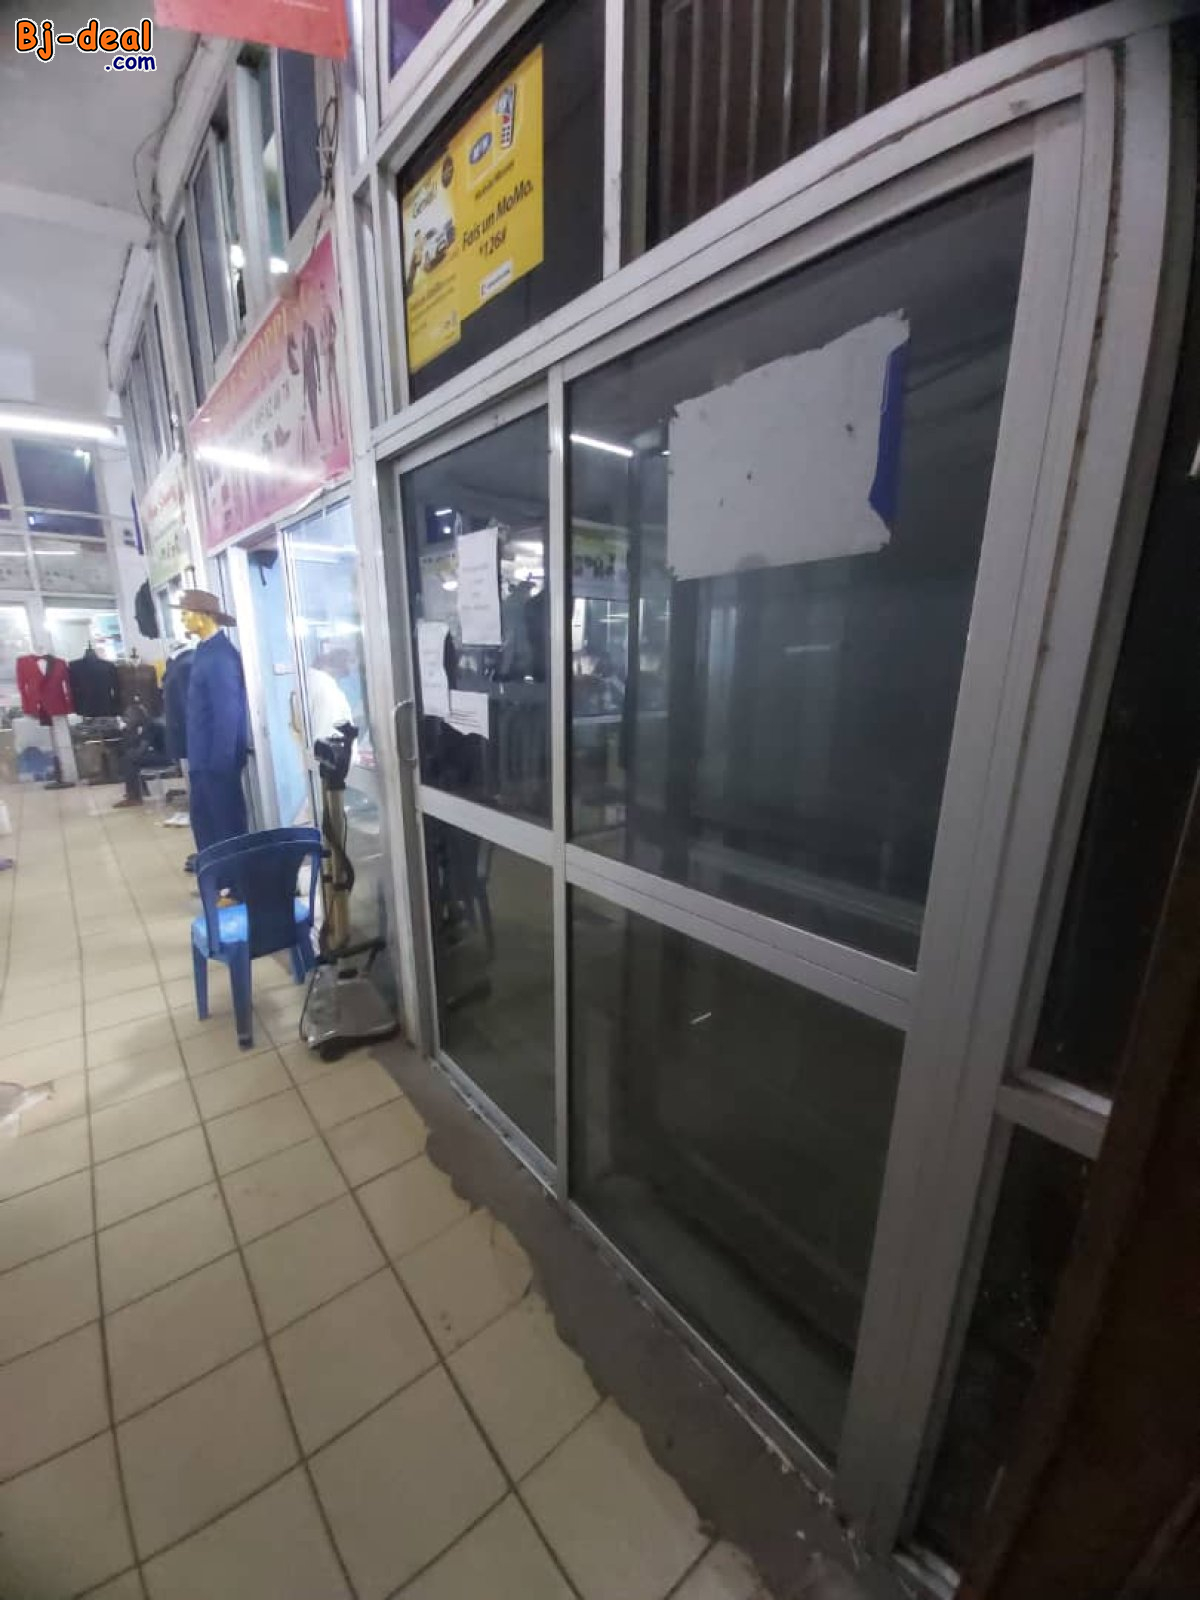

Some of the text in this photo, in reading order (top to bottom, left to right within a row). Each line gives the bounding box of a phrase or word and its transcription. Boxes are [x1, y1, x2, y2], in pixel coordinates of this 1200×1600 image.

[461, 178, 535, 251] Fais un MoMo.
